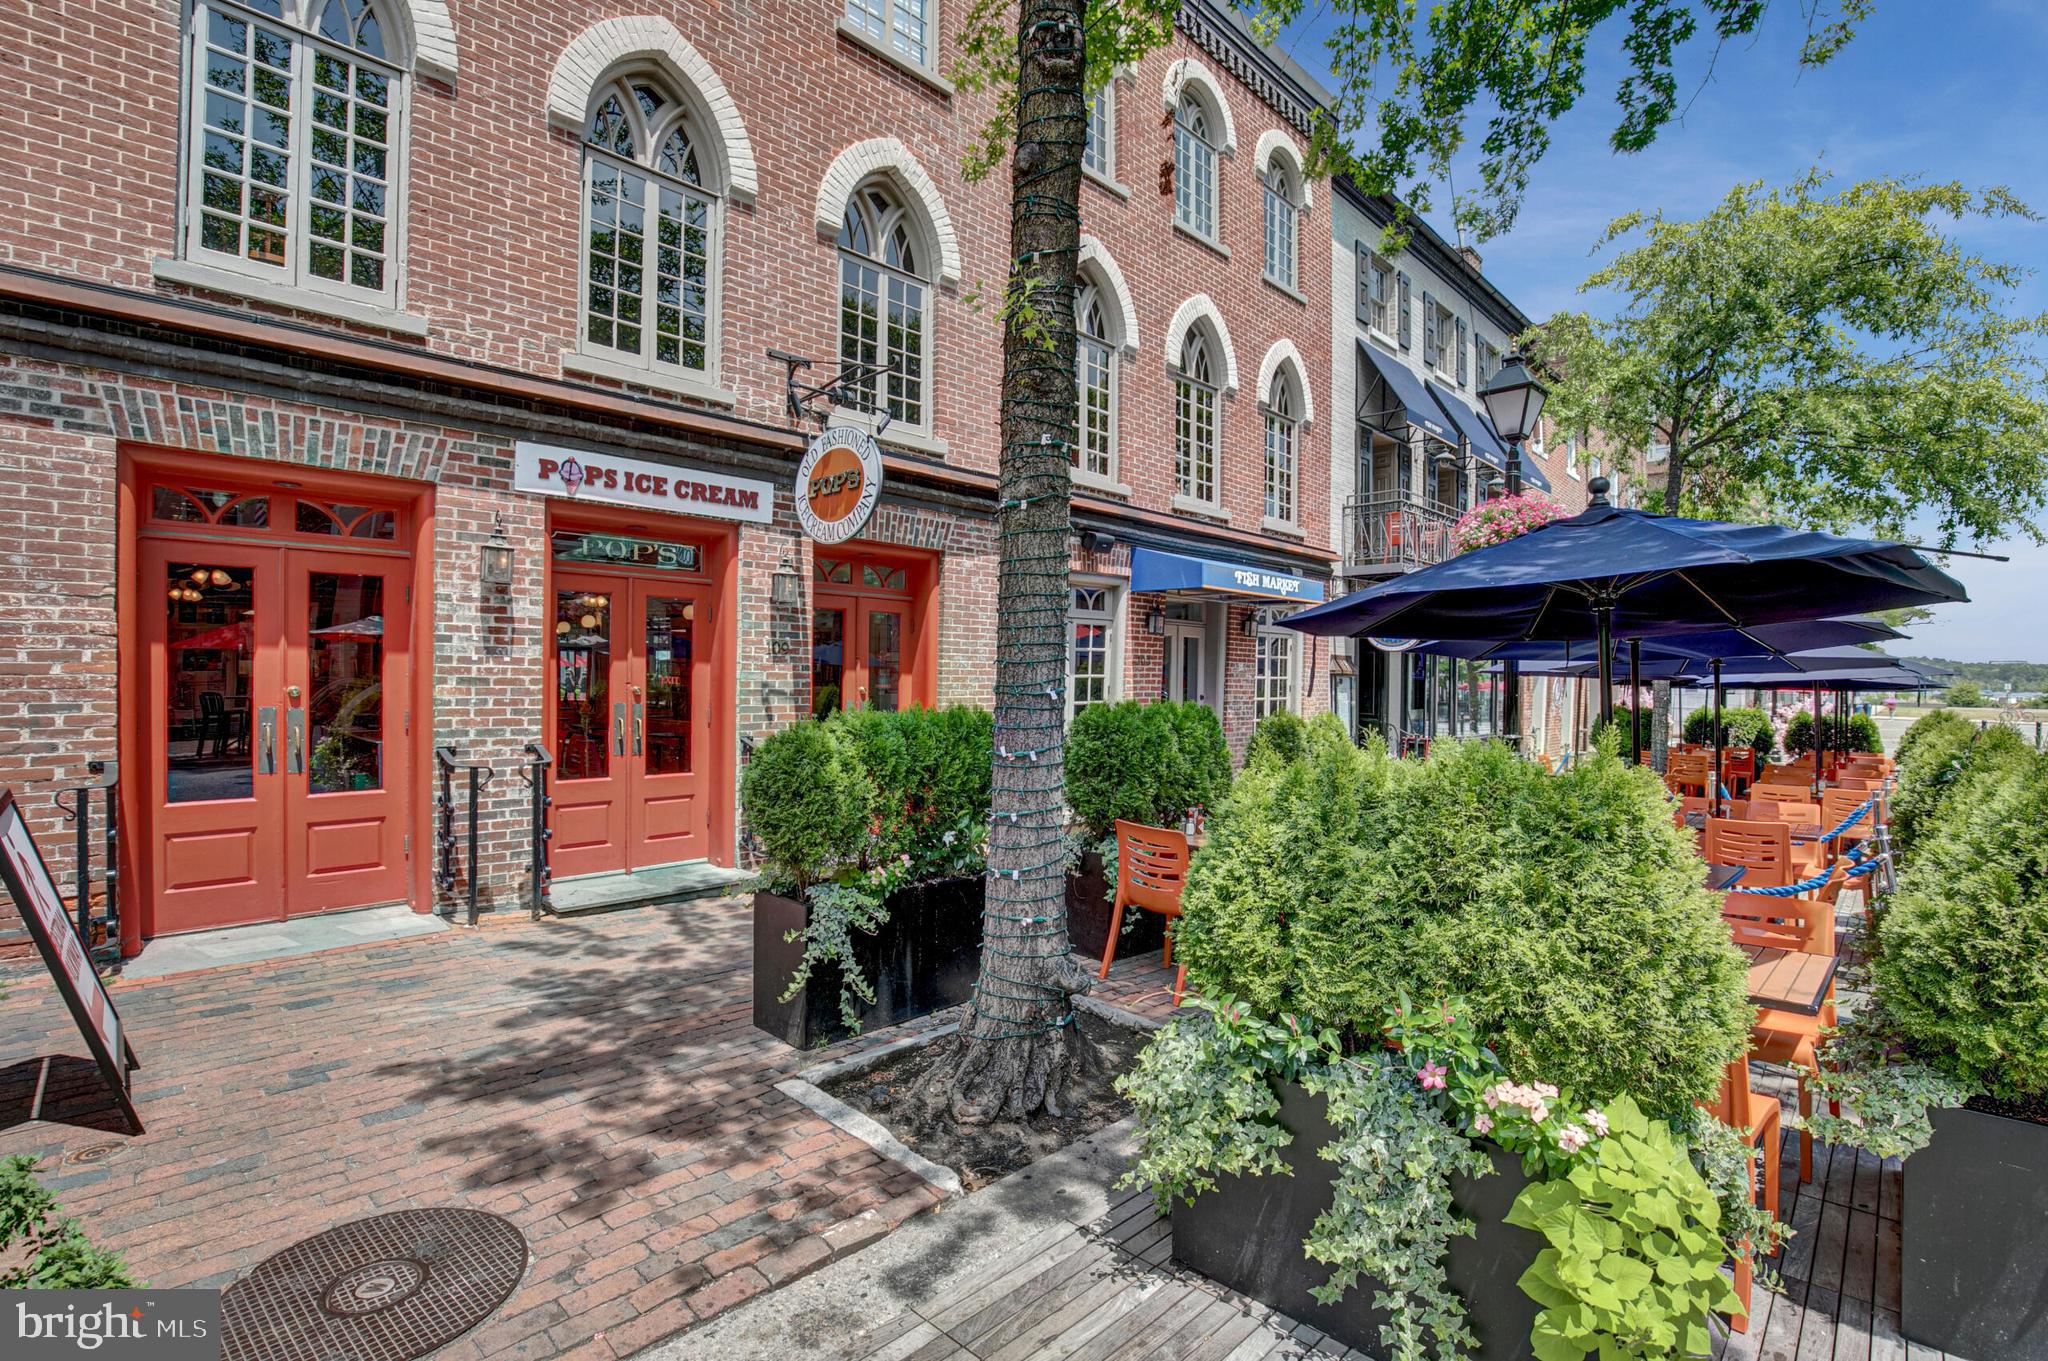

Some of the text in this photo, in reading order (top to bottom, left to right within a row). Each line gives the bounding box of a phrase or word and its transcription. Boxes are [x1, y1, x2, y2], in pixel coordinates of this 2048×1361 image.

[801, 429, 871, 478] OLD FASHIONED
[623, 471, 668, 497] ICE
[674, 479, 759, 510] CREAM
[808, 467, 862, 499] POP'S
[797, 476, 877, 541] ICE CREAM COMPANY
[581, 537, 678, 564] POP'S
[1234, 570, 1300, 596] FISH MARKET
